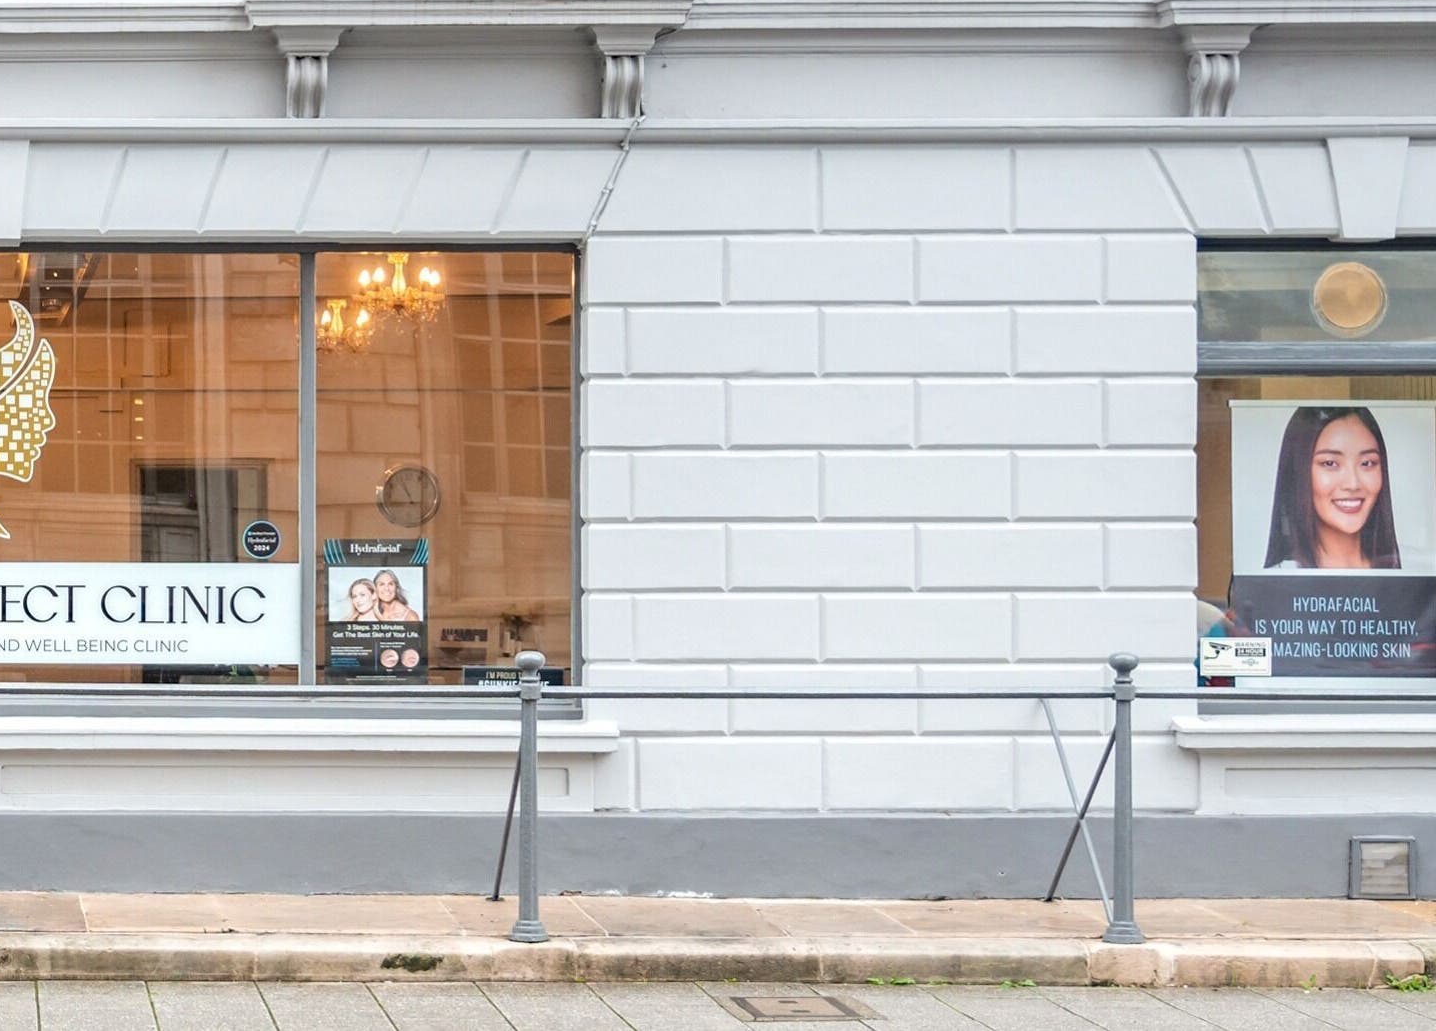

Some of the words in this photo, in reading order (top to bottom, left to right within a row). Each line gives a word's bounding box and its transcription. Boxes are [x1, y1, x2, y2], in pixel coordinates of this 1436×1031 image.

[100, 584, 266, 624] CLINIC
[1293, 597, 1380, 613] HYDRAFACIAL
[1255, 619, 1267, 635] IS
[1271, 619, 1303, 635] YOUR
[1307, 620, 1336, 635] WAY
[1340, 620, 1357, 635] TO
[1360, 620, 1419, 637] HEALTHY,
[25, 638, 71, 652] WELL
[76, 639, 129, 653] BEING
[133, 639, 189, 653] CLINIC
[1272, 642, 1378, 658] MAZING-LOOKING
[1382, 643, 1411, 658] SKIN
